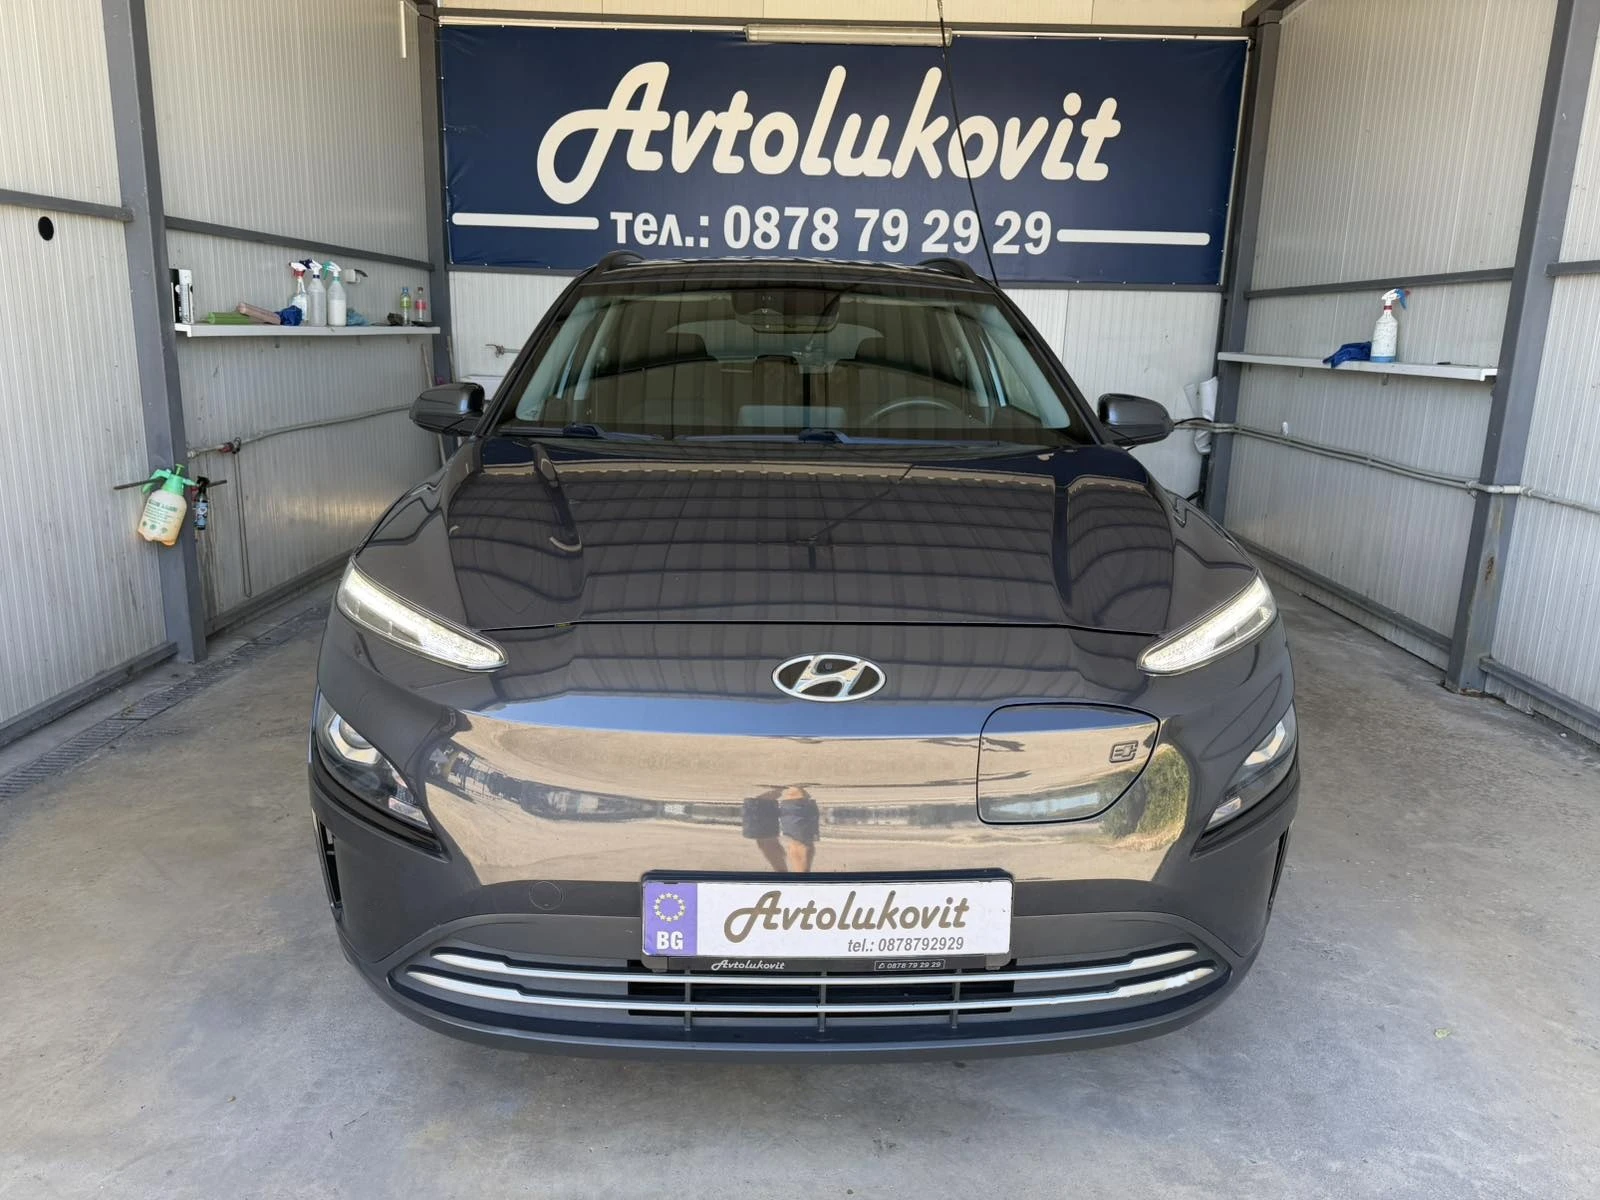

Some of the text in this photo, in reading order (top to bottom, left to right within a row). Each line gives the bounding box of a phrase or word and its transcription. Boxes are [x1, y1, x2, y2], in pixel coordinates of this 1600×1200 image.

[536, 61, 1121, 204] Avtolukovit
[610, 205, 1051, 255] тел.: 0878 79 29 29
[724, 890, 969, 944] Avtolukovit
[656, 931, 683, 950] BG
[847, 937, 964, 953] tel.: 0878792929
[711, 959, 785, 971] Avtolukovit
